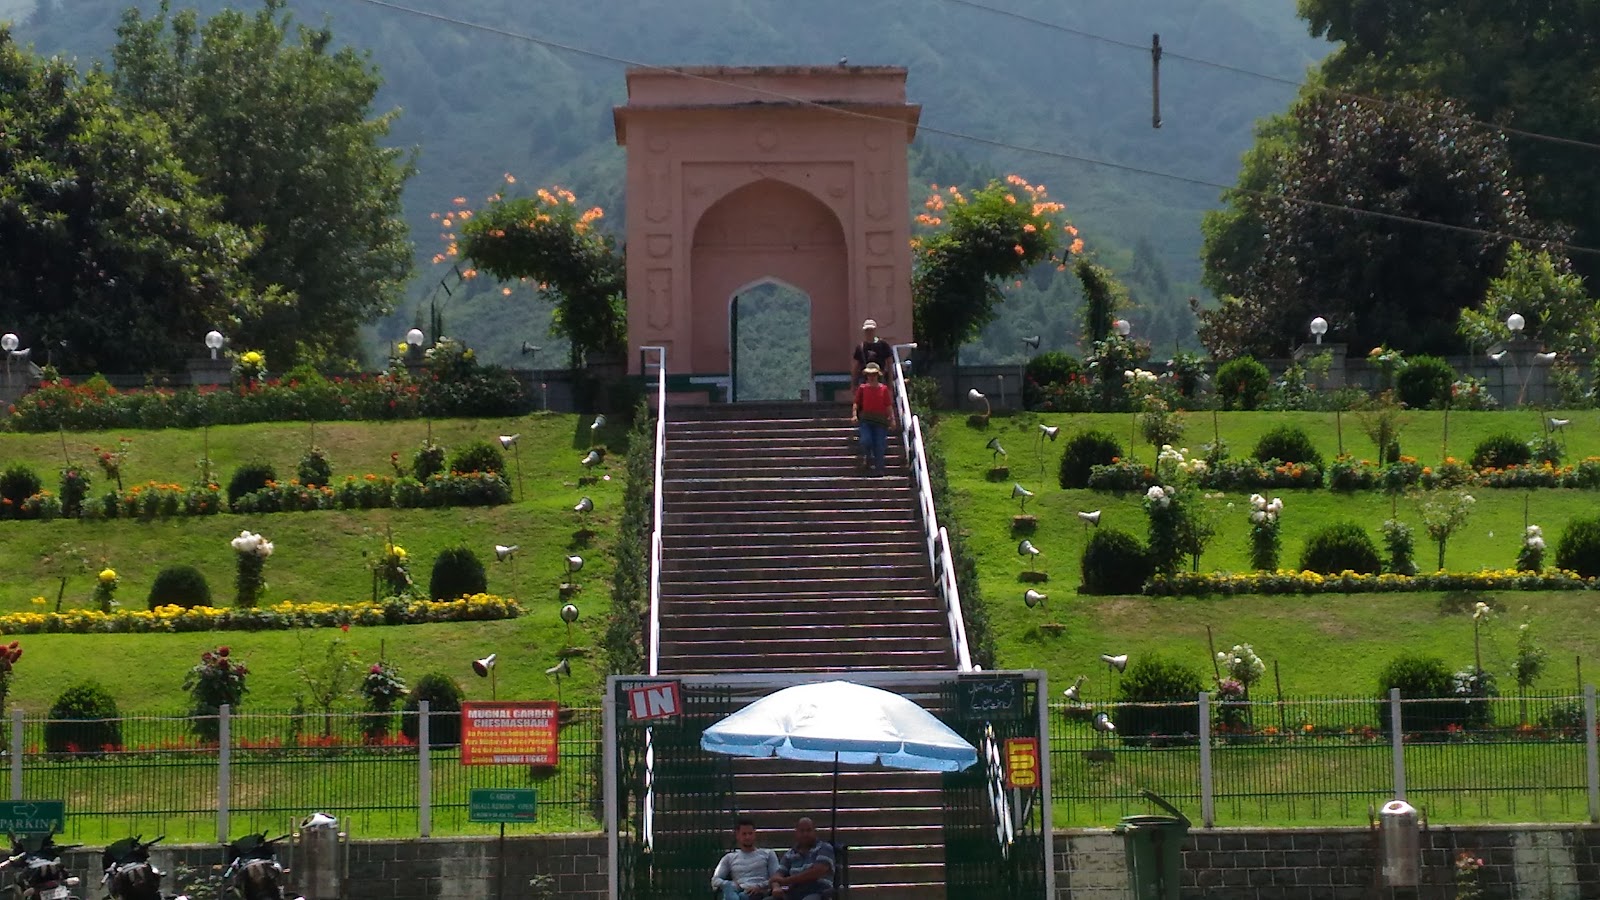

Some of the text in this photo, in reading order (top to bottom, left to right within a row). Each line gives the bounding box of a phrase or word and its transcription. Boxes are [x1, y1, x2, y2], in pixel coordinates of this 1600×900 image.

[468, 710, 554, 718] MUGHAL GARDEN
[634, 687, 675, 718] IN
[1009, 742, 1036, 785] OUT
